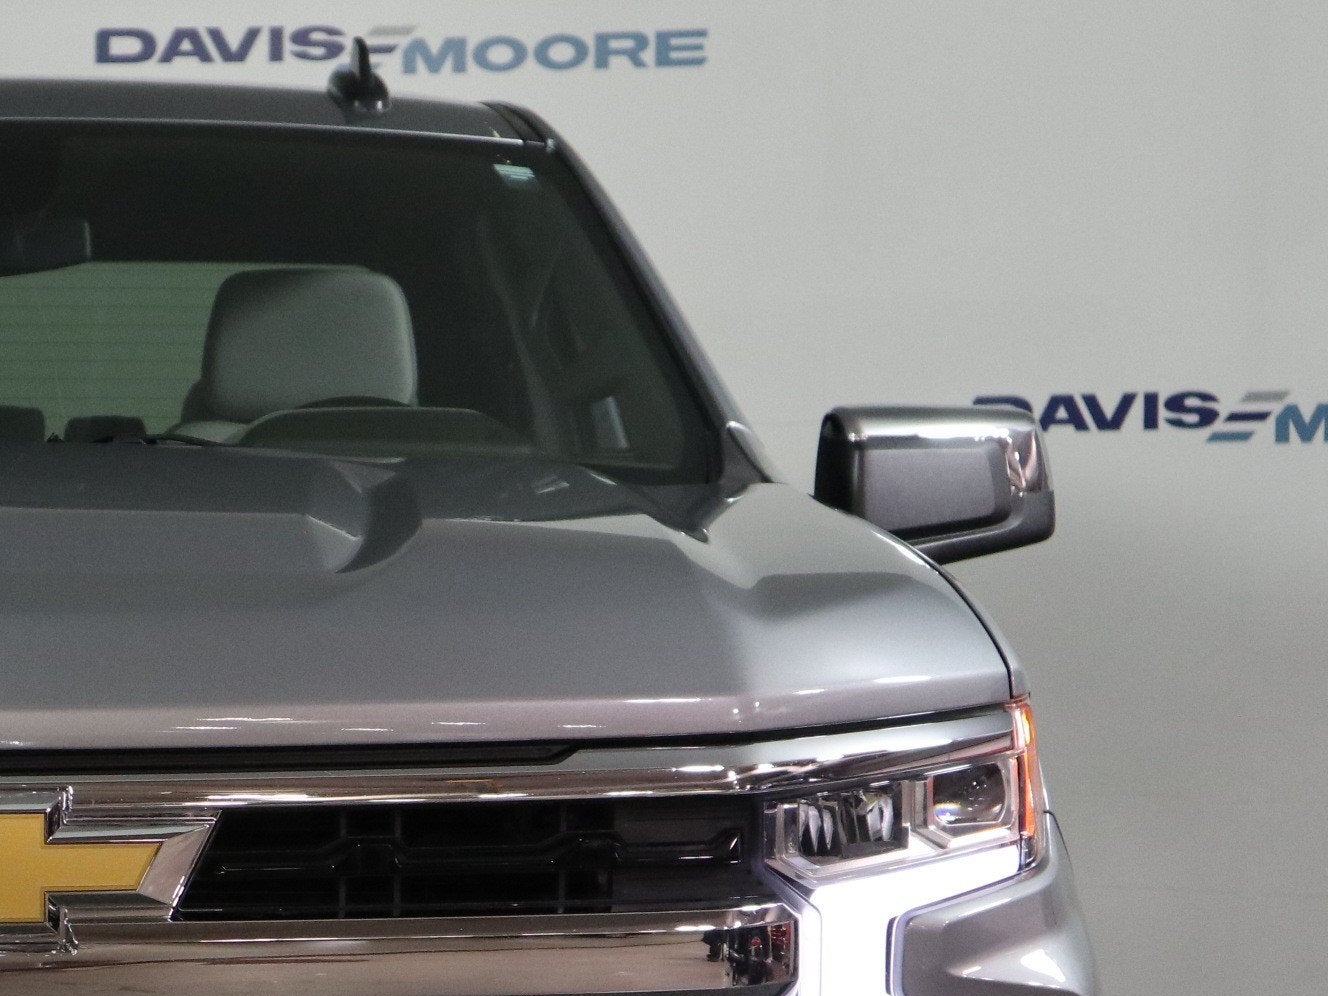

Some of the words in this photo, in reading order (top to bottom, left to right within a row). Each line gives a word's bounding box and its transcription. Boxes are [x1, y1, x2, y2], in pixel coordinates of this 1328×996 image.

[94, 25, 346, 64] DAVIS
[401, 28, 709, 75] MOORE
[973, 390, 1220, 432] AVIS
